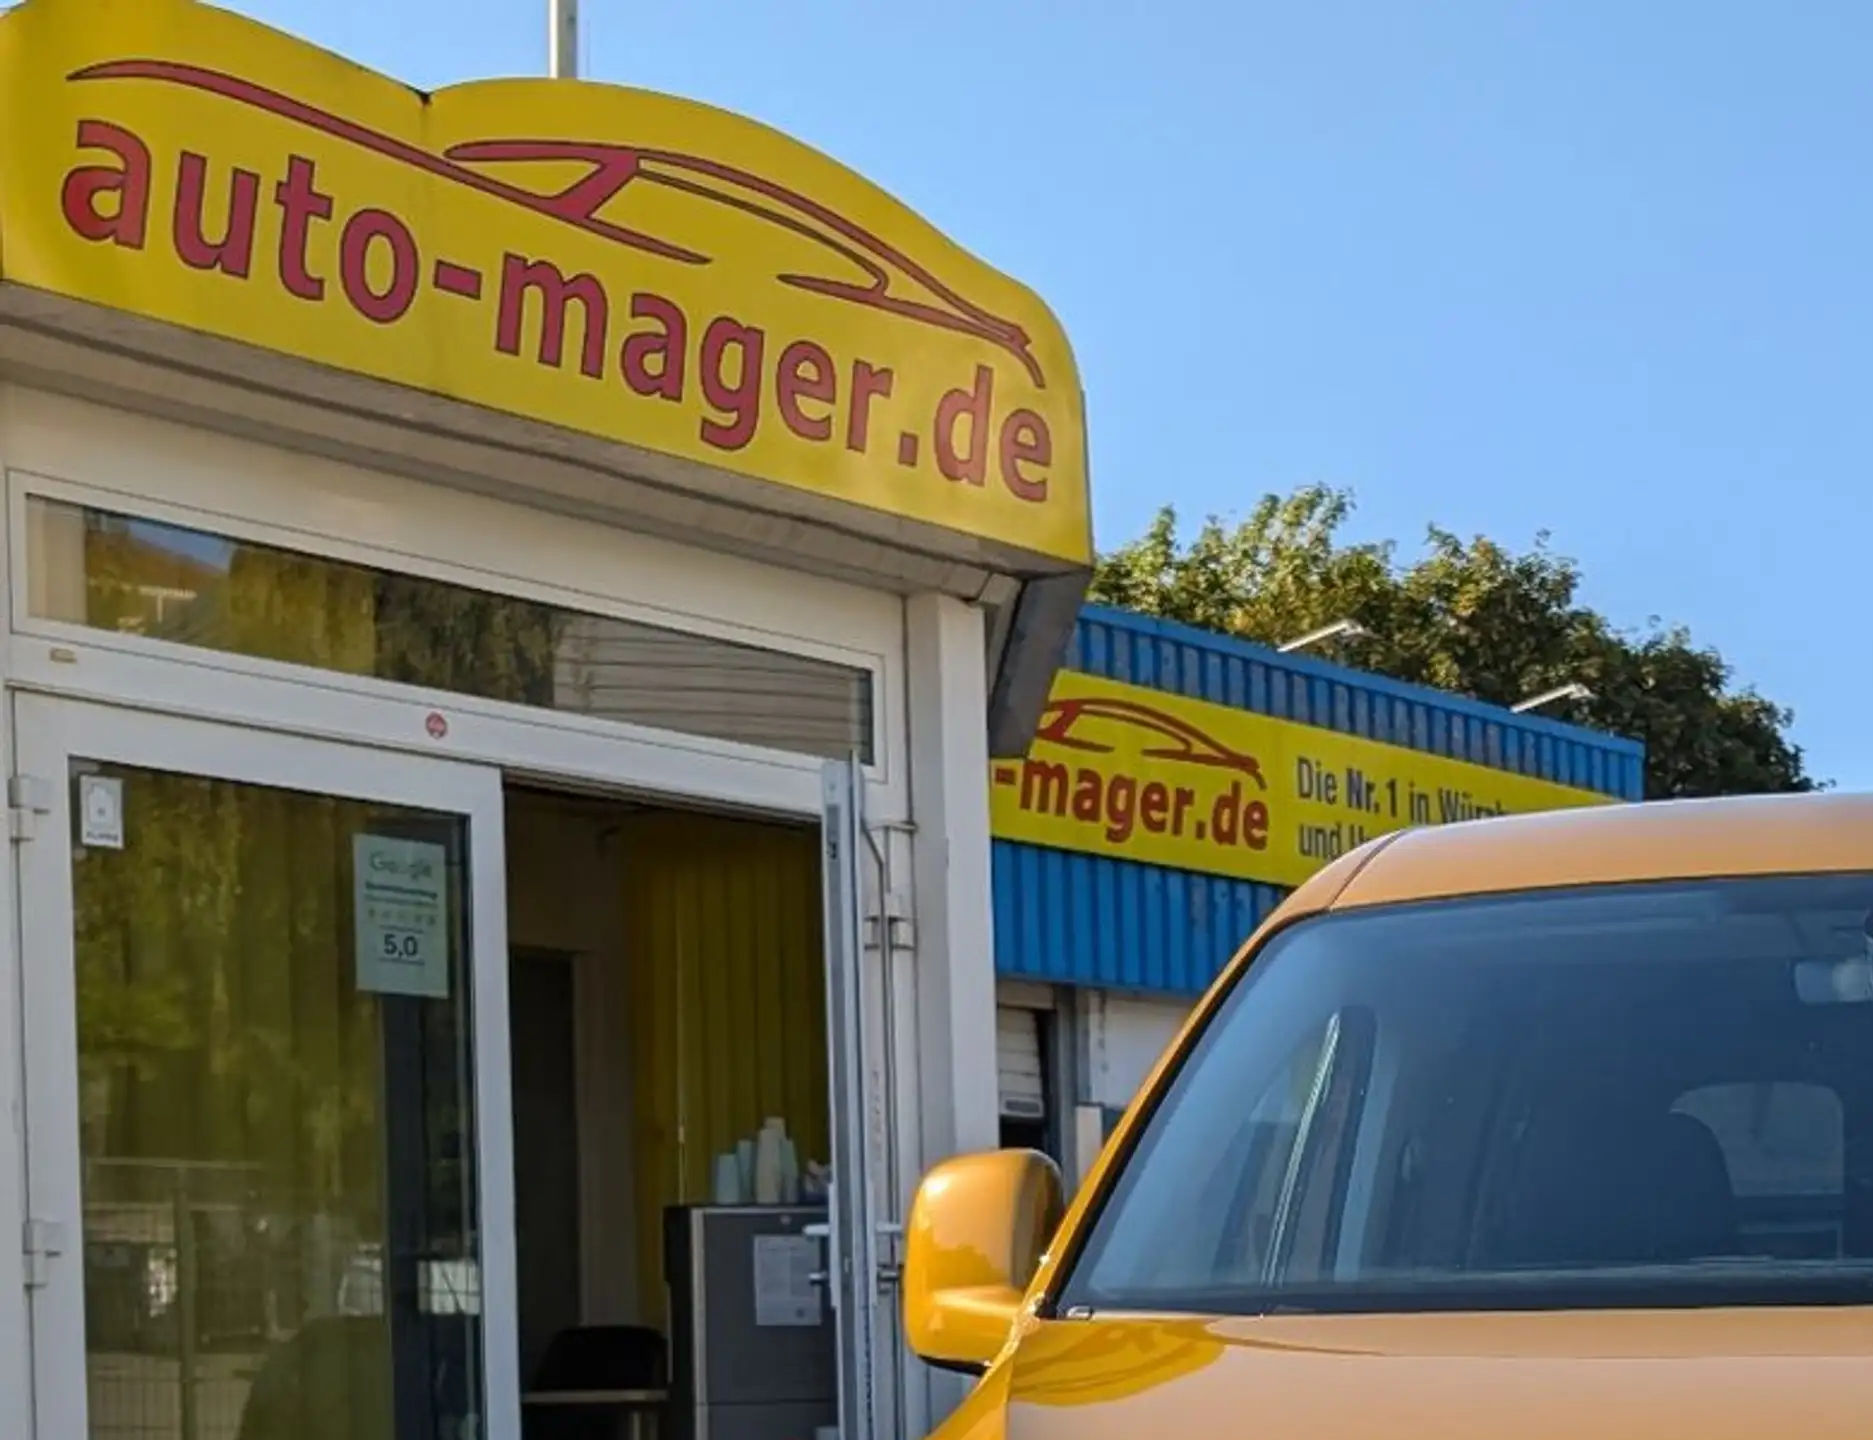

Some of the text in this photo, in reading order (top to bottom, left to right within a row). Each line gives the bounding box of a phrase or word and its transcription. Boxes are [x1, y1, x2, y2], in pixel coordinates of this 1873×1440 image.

[60, 118, 1053, 503] auto-mager.de
[1297, 756, 1337, 805] Die
[1346, 767, 1381, 815] Nr.
[1386, 777, 1398, 818] 1
[1409, 780, 1430, 824] in
[1299, 822, 1342, 860] und
[383, 933, 418, 957] 5.0
